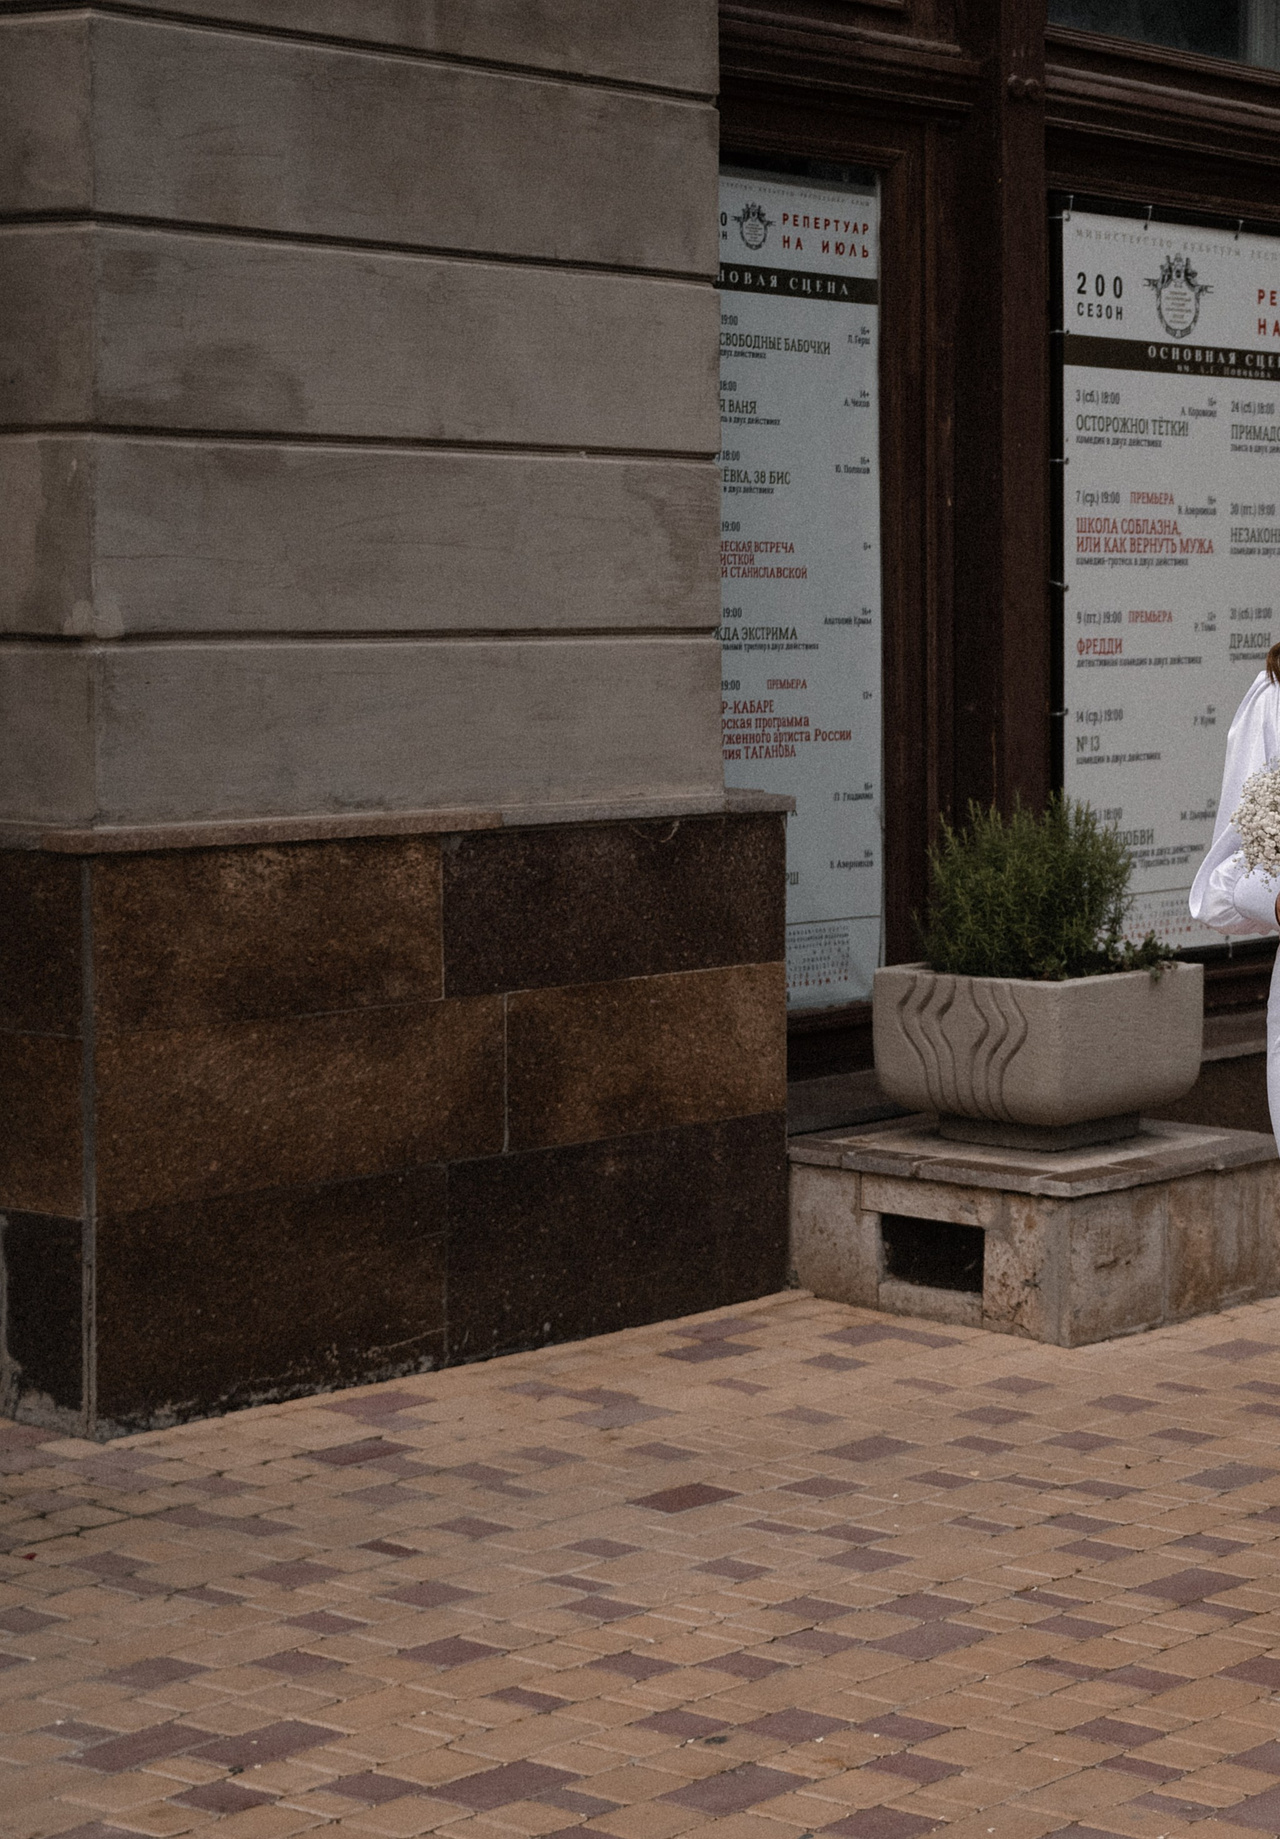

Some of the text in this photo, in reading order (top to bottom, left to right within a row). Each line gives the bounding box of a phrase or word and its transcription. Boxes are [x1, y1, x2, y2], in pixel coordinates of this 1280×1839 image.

[782, 213, 869, 235] РЕПЕРТУАР
[782, 236, 869, 258] НА ИЮЛЬ
[789, 277, 849, 296] СЦЕНА
[1076, 271, 1124, 299] 200
[1076, 302, 1124, 321] СЕЗОН
[720, 332, 831, 354] СВОБОДНЫЕ БАБОЧКИ
[1148, 345, 1236, 365] ОСНОВНАЯ
[1223, 367, 1271, 378] Новикова
[1101, 391, 1120, 405] 18:00
[728, 399, 757, 414] ВАНЯ
[1231, 401, 1239, 413] 24
[1076, 414, 1188, 437] ОСТОРОЖНО! ТЁТКИ!
[1076, 436, 1105, 445] комедия
[721, 466, 791, 485] ЁВКА, 38 БИС
[1101, 491, 1120, 504] 19:00
[1130, 491, 1174, 505] ПРЕМЬЕРА
[722, 521, 740, 532] 19:00
[1076, 517, 1182, 536] ШКОЛА СОБЛАЗНА,
[754, 541, 795, 554] ВСТРЕЧА
[1076, 536, 1214, 554] ИЛИ КАК ВЕРНУТЬ МУЖА
[730, 565, 808, 579] СТАНИСЛАВСКОЙ
[723, 607, 742, 618] 19:00
[1103, 611, 1122, 624] 19:00
[1128, 610, 1173, 623] ПРЕМЬЕРА
[742, 626, 798, 640] ЭКСТРИМА
[1229, 633, 1271, 649] ДРАКОН
[1076, 638, 1122, 655] ФРЕДДИ
[767, 679, 808, 690] ПРЕМЬЕРА
[1076, 711, 1084, 722] 14
[1104, 708, 1123, 721] 19:00
[755, 716, 810, 732] программа
[773, 731, 810, 745] артиста
[814, 728, 852, 742] России
[1090, 735, 1100, 752] 13
[744, 745, 796, 759] ТАГАНОВА
[1115, 829, 1154, 847] ЛЮБВИ
